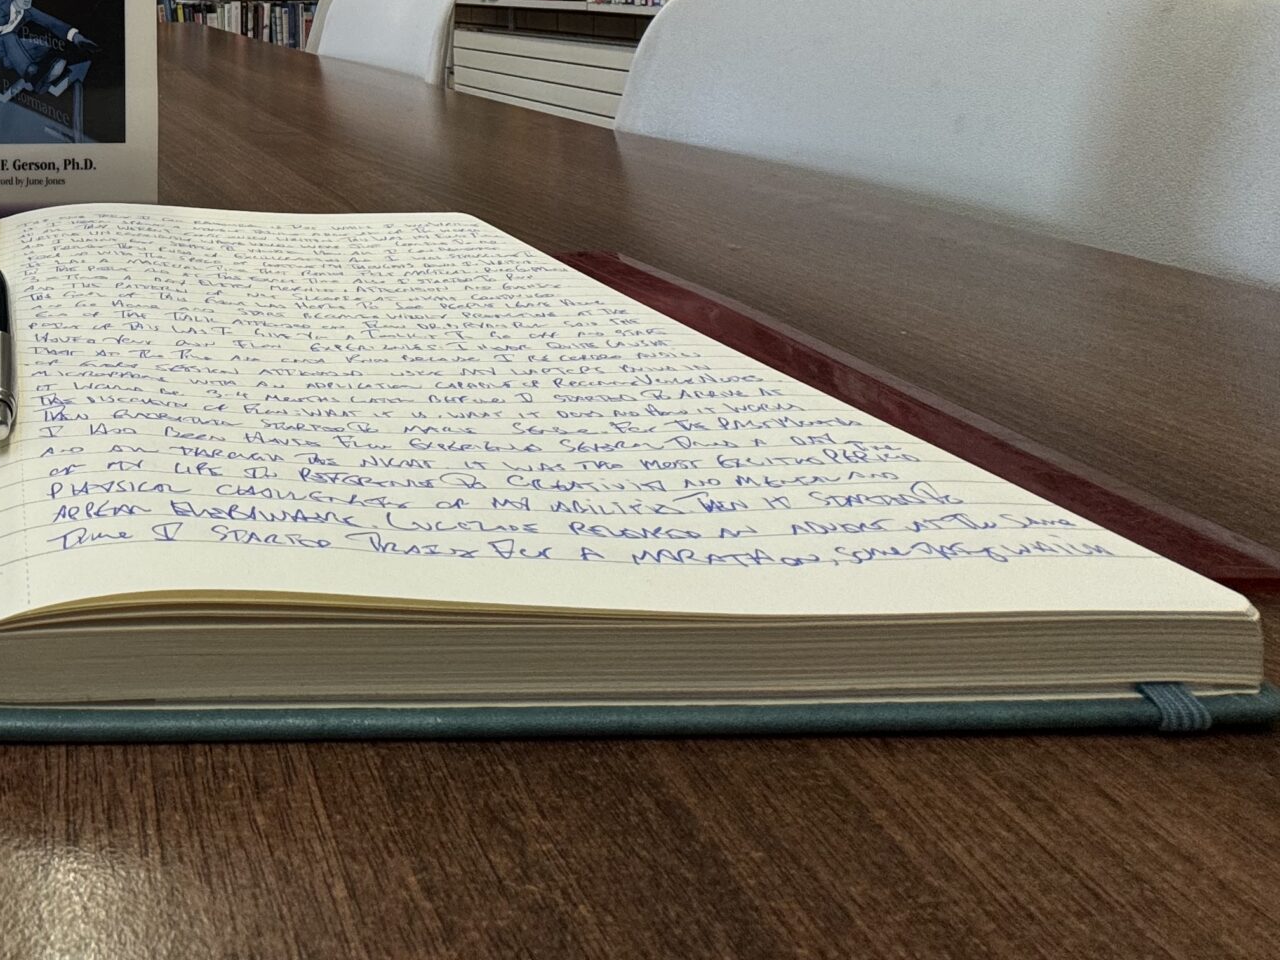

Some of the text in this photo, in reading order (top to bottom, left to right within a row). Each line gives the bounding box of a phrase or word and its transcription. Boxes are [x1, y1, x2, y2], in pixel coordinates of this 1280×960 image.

[22, 26, 66, 52] Practice
[0, 159, 10, 171] F.
[13, 158, 60, 173] Gerson,
[63, 158, 97, 171] Ph.D.
[15, 177, 24, 188] by
[25, 177, 43, 188] June
[45, 176, 66, 187] Jones
